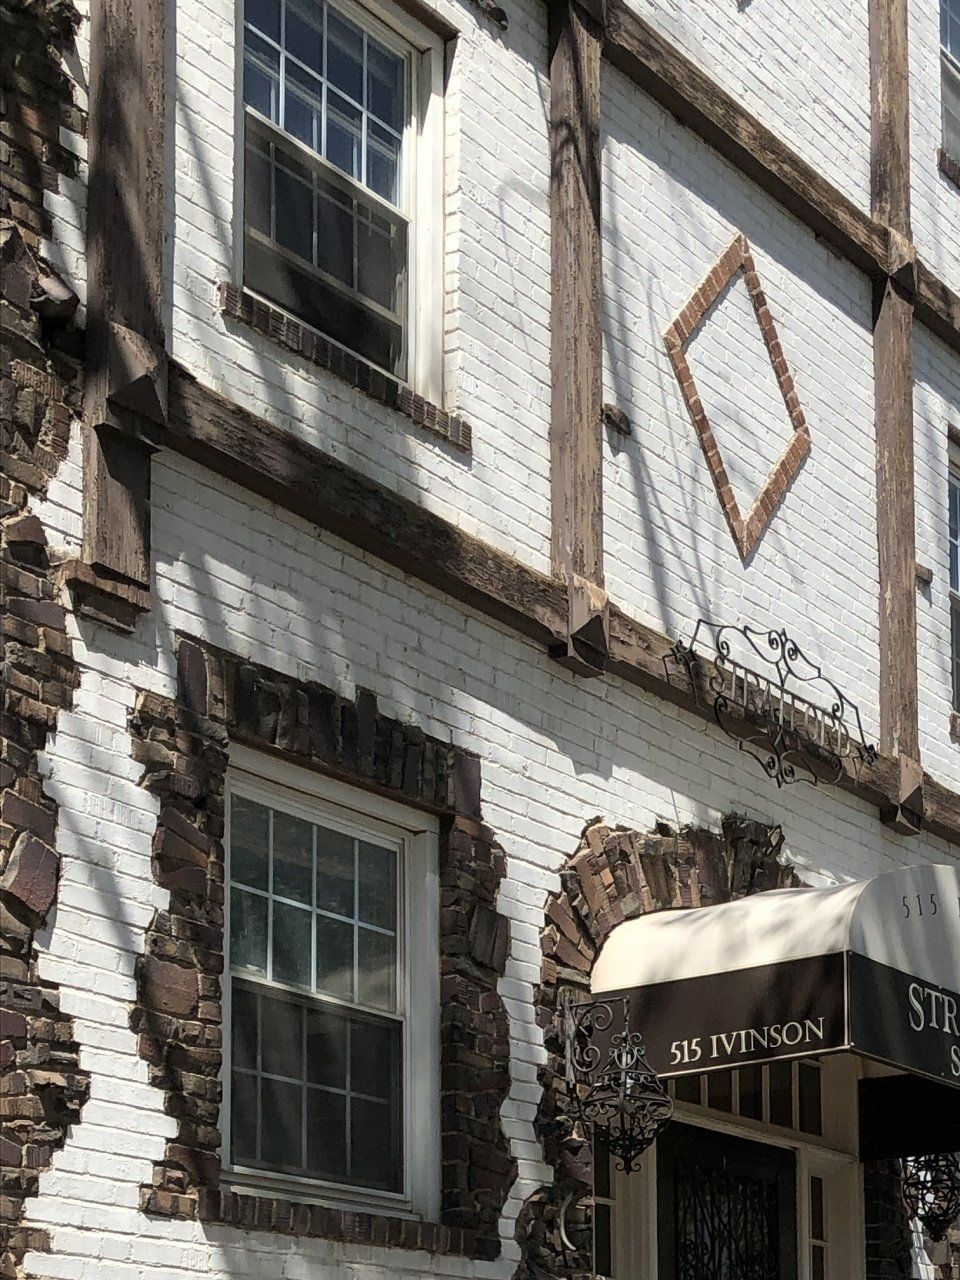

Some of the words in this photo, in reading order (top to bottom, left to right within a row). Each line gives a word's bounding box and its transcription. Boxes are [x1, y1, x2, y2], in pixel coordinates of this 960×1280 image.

[902, 893, 937, 919] 515
[669, 1037, 702, 1066] 515
[709, 1016, 826, 1059] IVINSON
